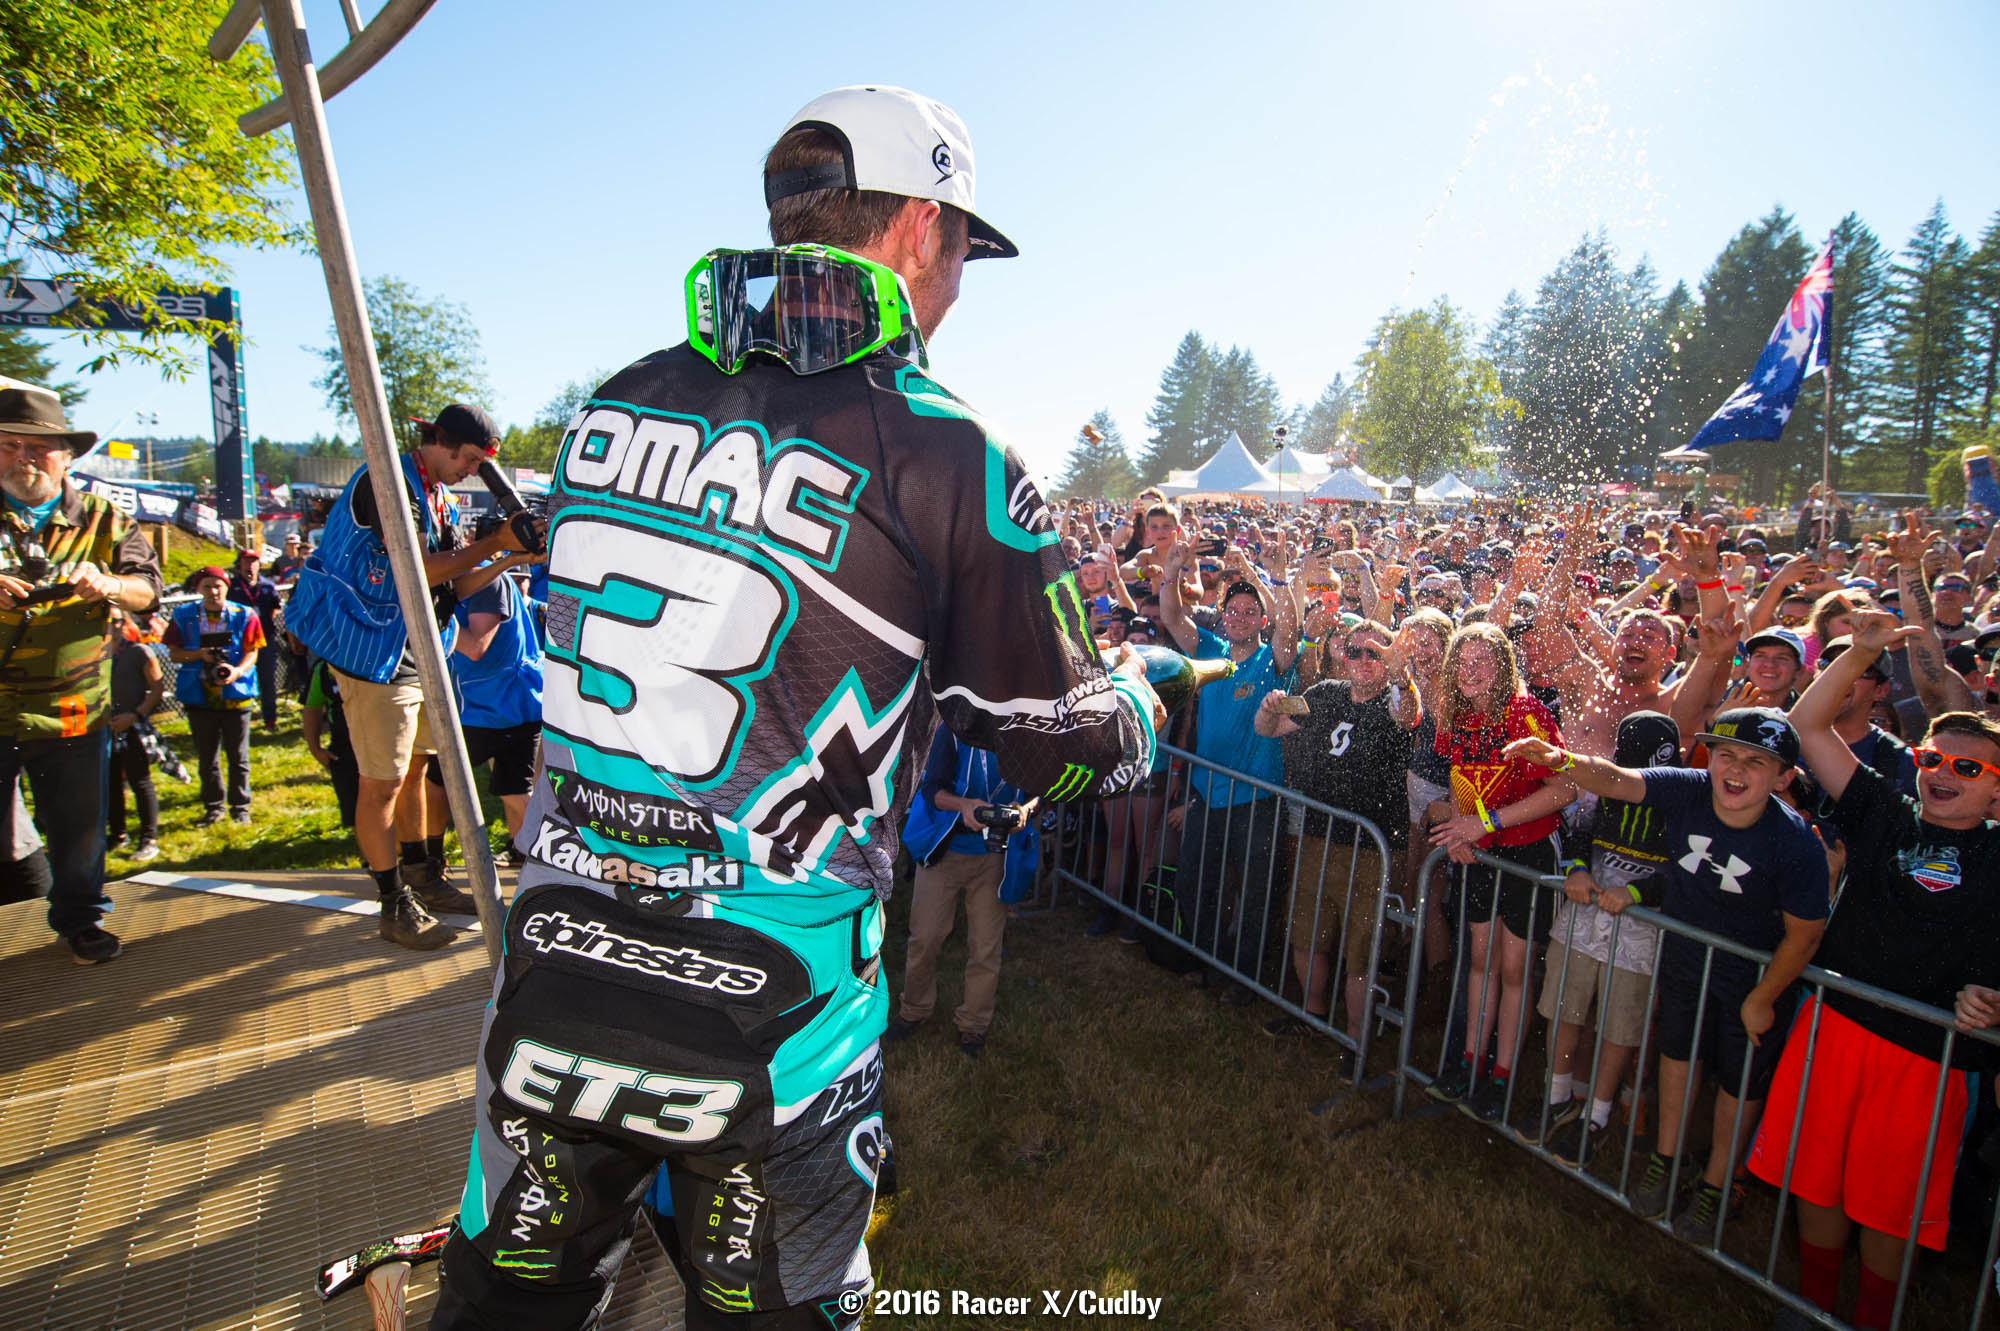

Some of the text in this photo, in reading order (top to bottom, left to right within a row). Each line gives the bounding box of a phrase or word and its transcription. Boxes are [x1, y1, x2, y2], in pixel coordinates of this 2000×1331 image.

[552, 406, 857, 560] TOMAC
[541, 518, 785, 779] 3
[1053, 676, 1113, 722] Kawa
[529, 818, 743, 891] Kawasaki
[589, 819, 690, 847] ENERGY
[522, 910, 768, 996] alpinestars
[501, 1038, 744, 1144] ET3
